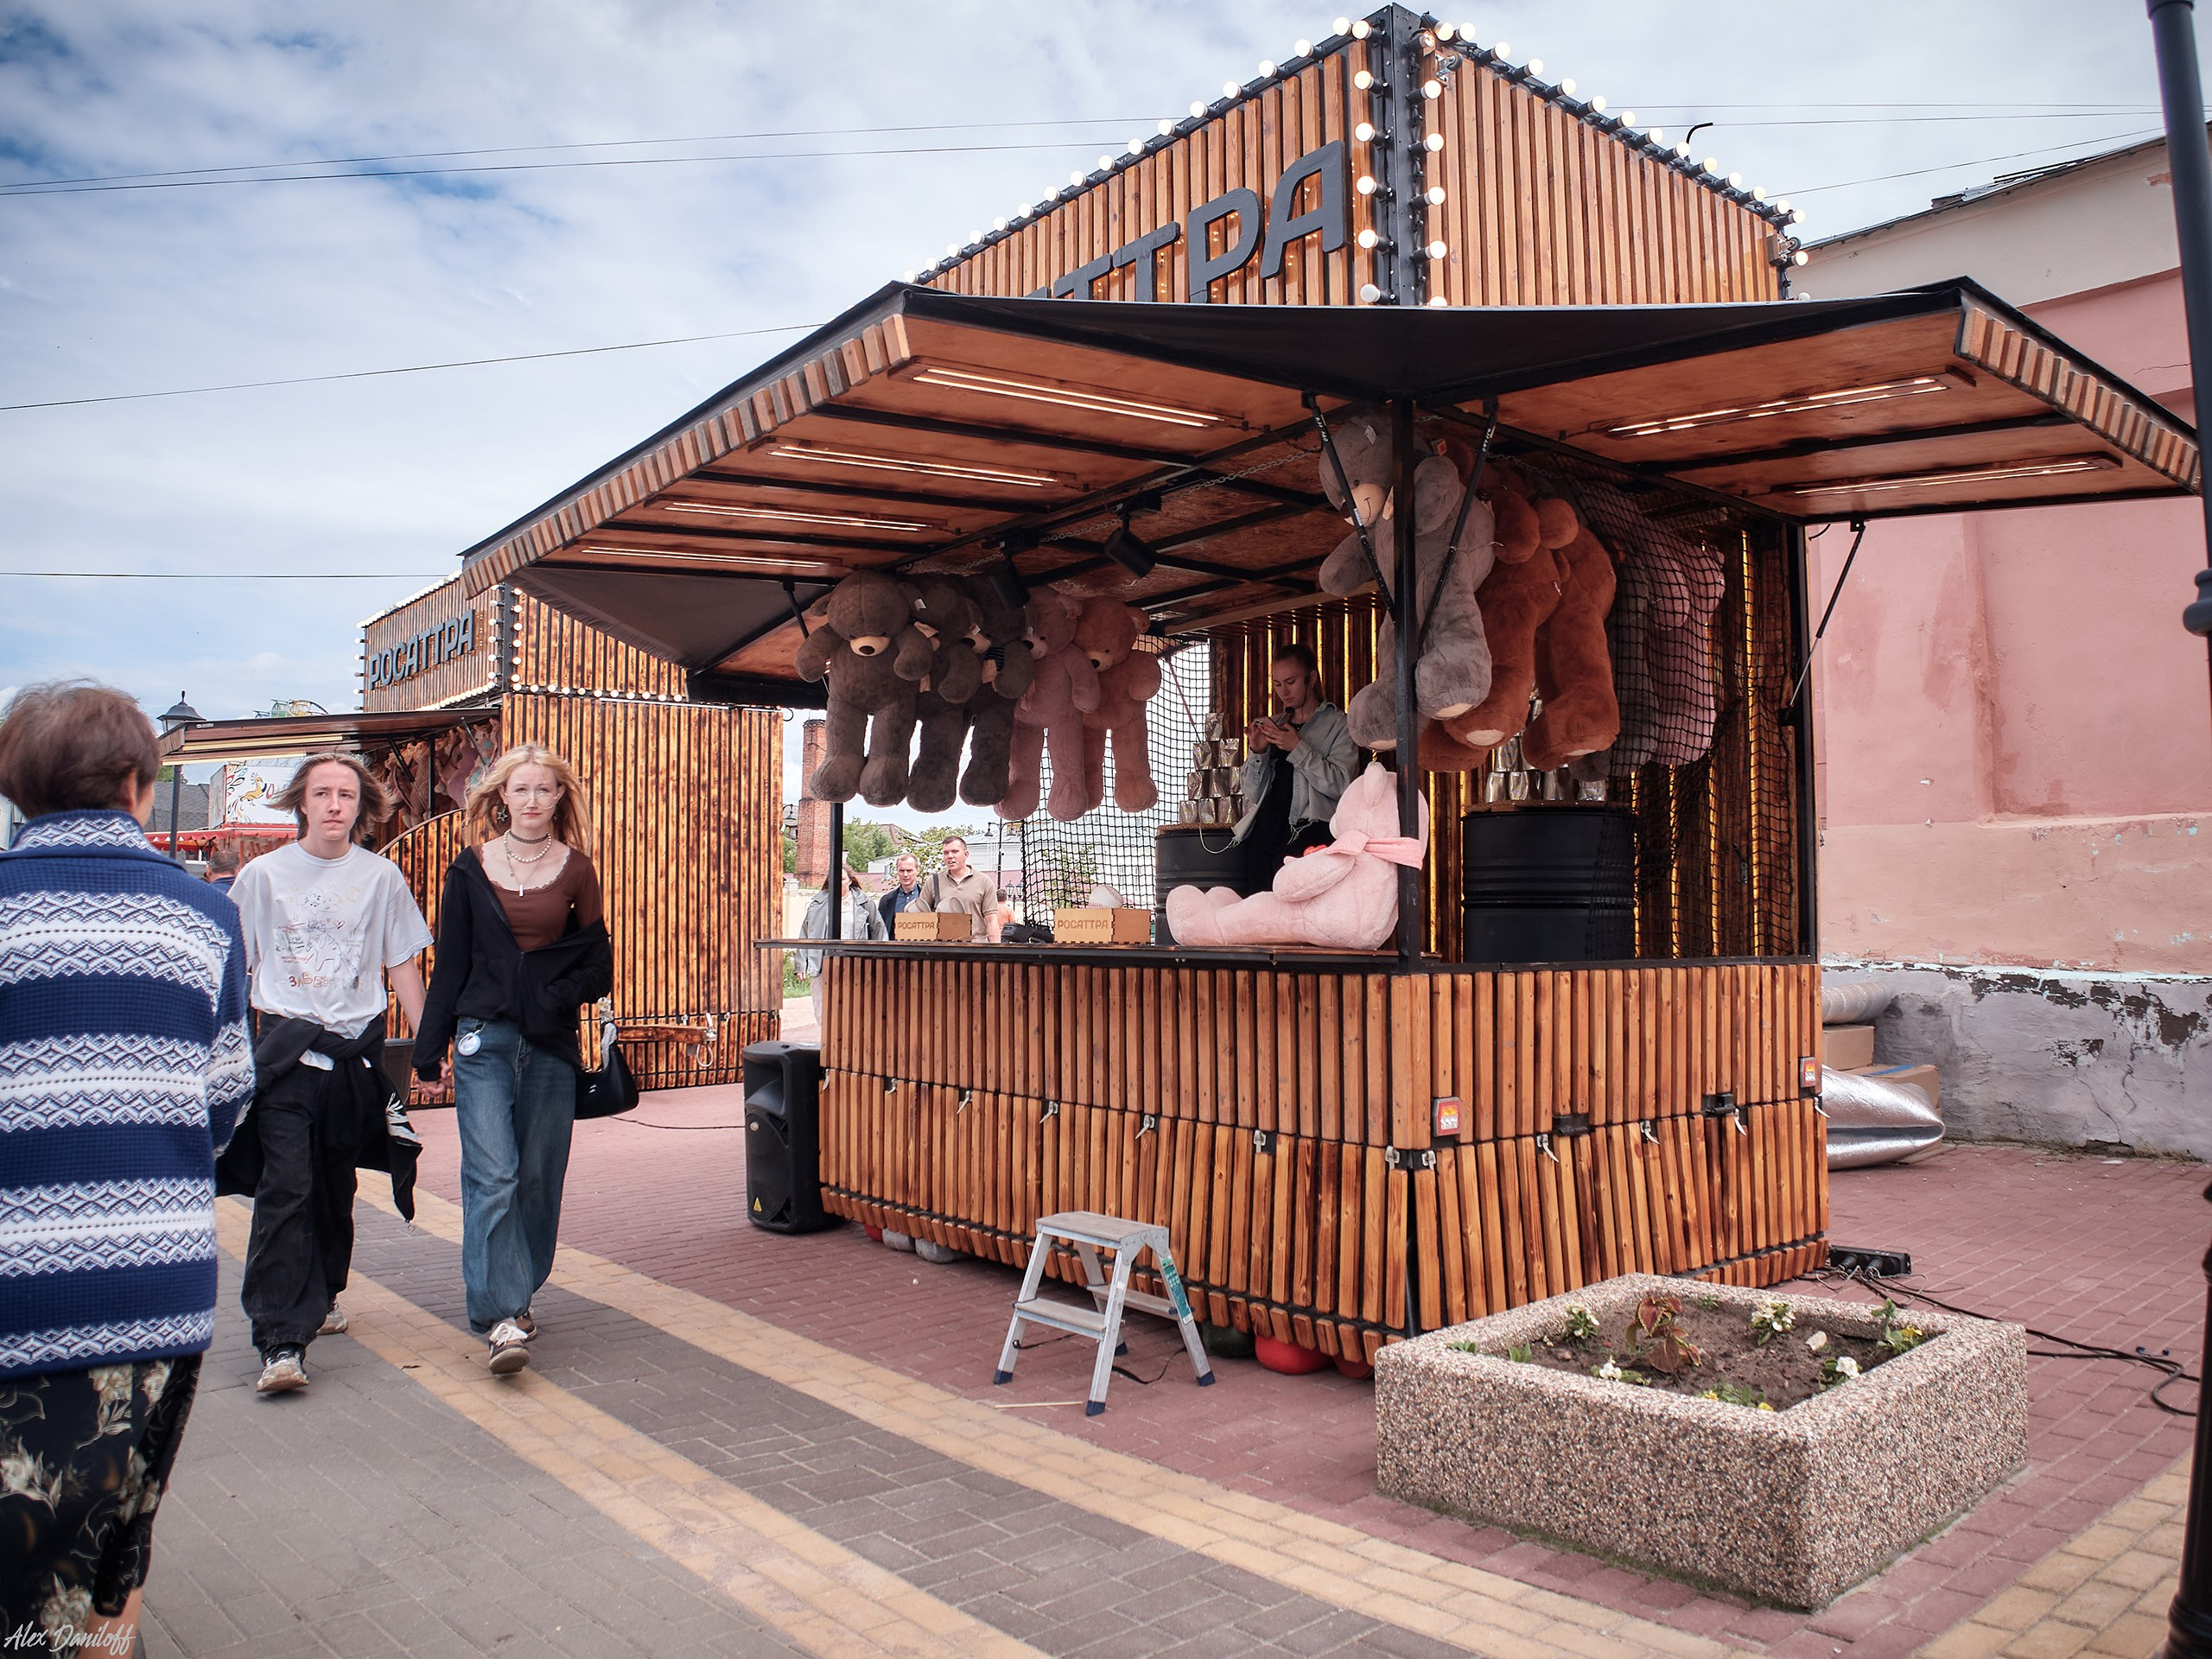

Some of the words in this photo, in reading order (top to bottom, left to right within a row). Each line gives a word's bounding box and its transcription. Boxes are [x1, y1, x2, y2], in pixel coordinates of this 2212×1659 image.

[1026, 140, 1350, 302] ТТРА
[369, 608, 475, 690] РОСАТТРА
[897, 921, 935, 930] РОСАТТРА
[1058, 919, 1109, 930] РОСАТТРА
